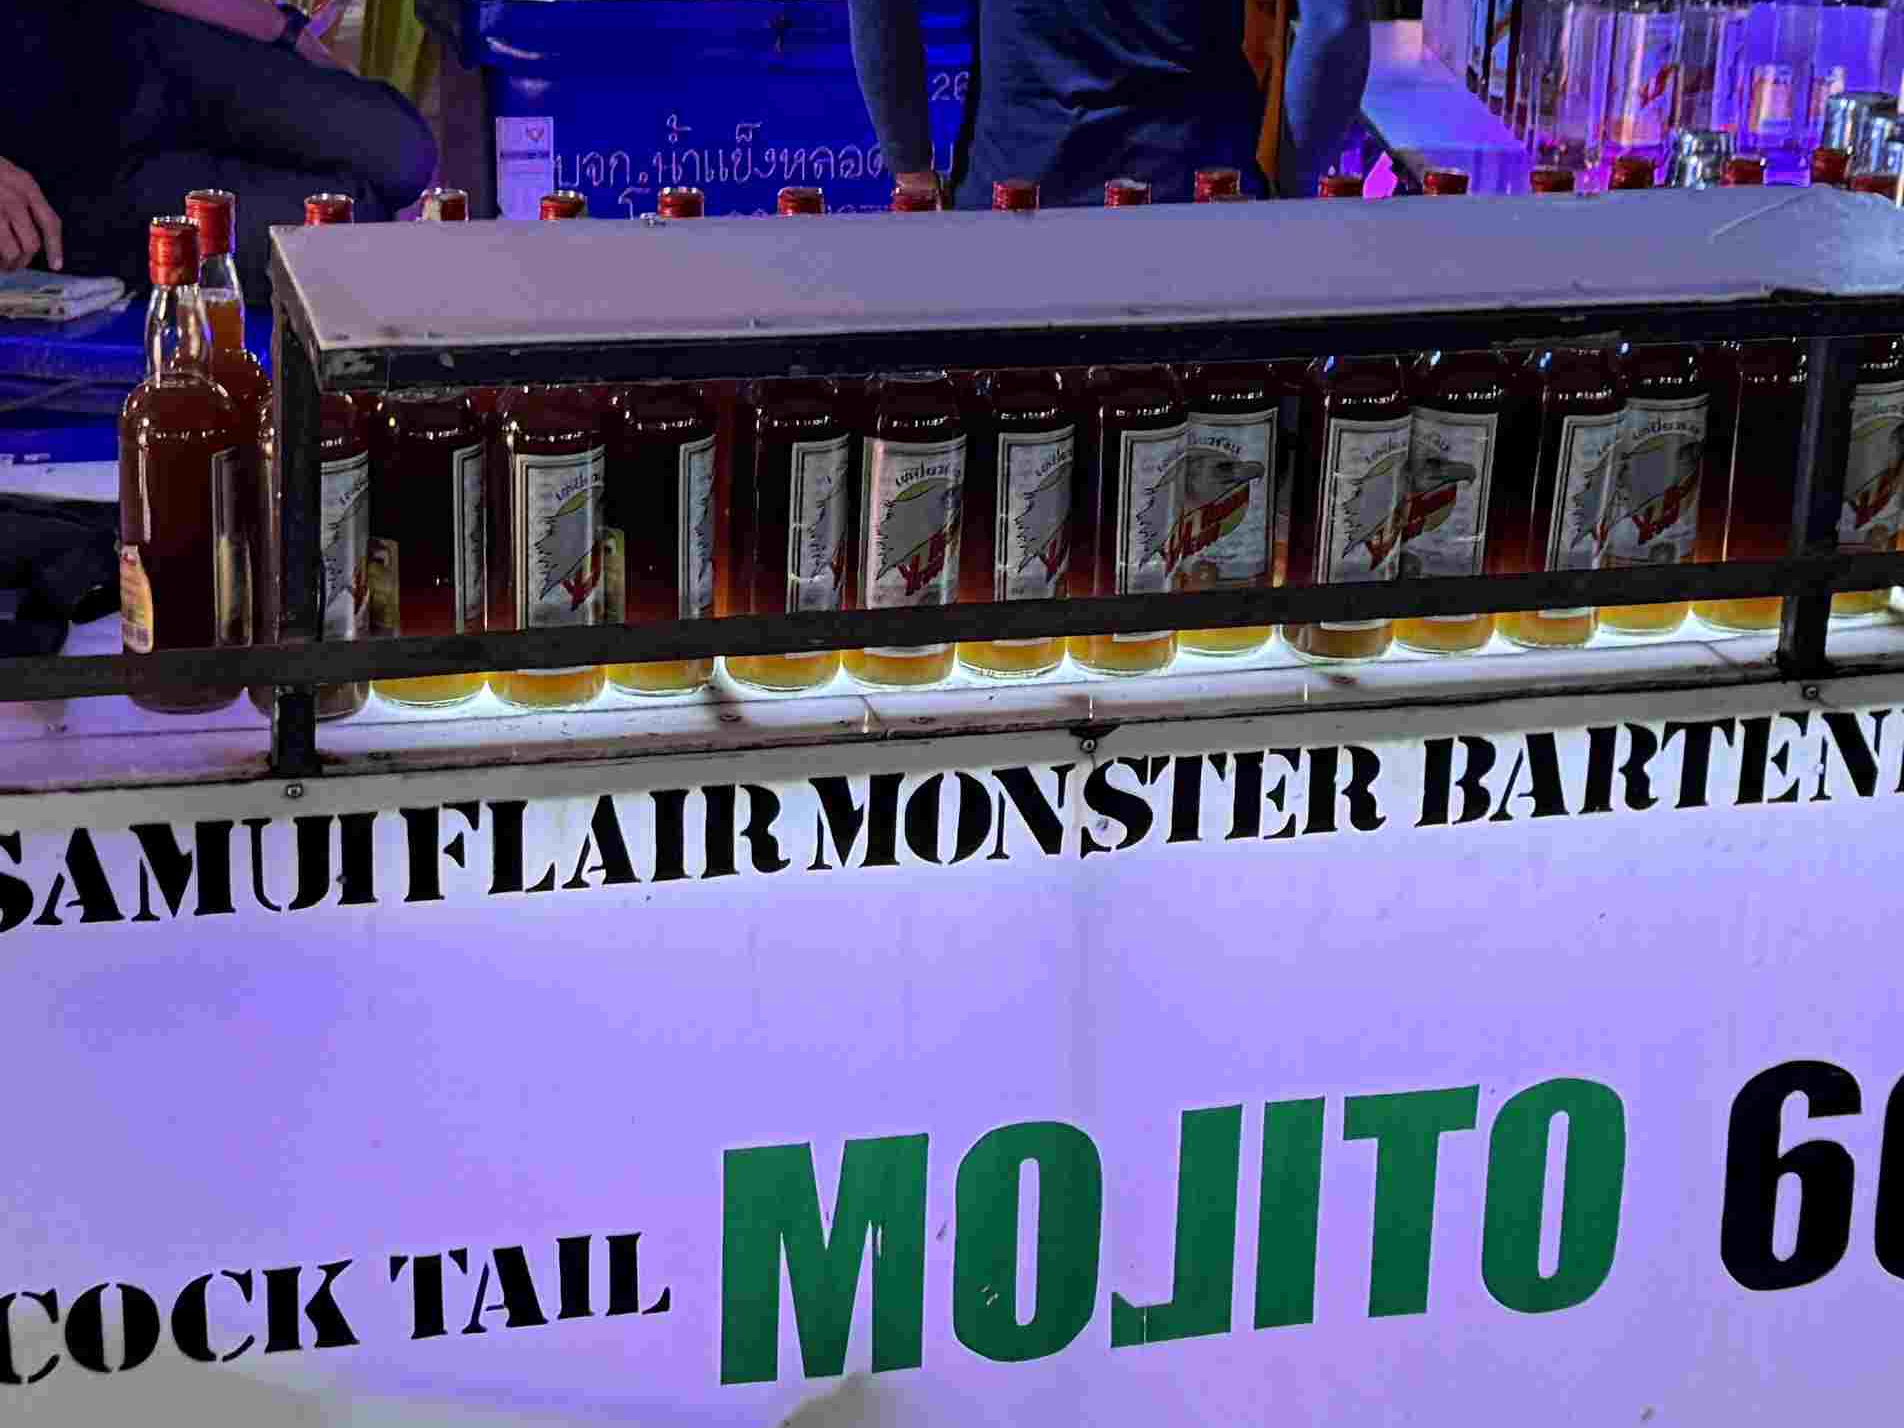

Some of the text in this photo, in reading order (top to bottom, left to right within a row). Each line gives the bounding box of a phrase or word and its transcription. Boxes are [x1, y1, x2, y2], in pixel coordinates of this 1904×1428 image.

[399, 780, 793, 904] FLAIR
[807, 744, 1388, 869] MONSTER
[718, 1078, 1625, 1386] MOJITO
